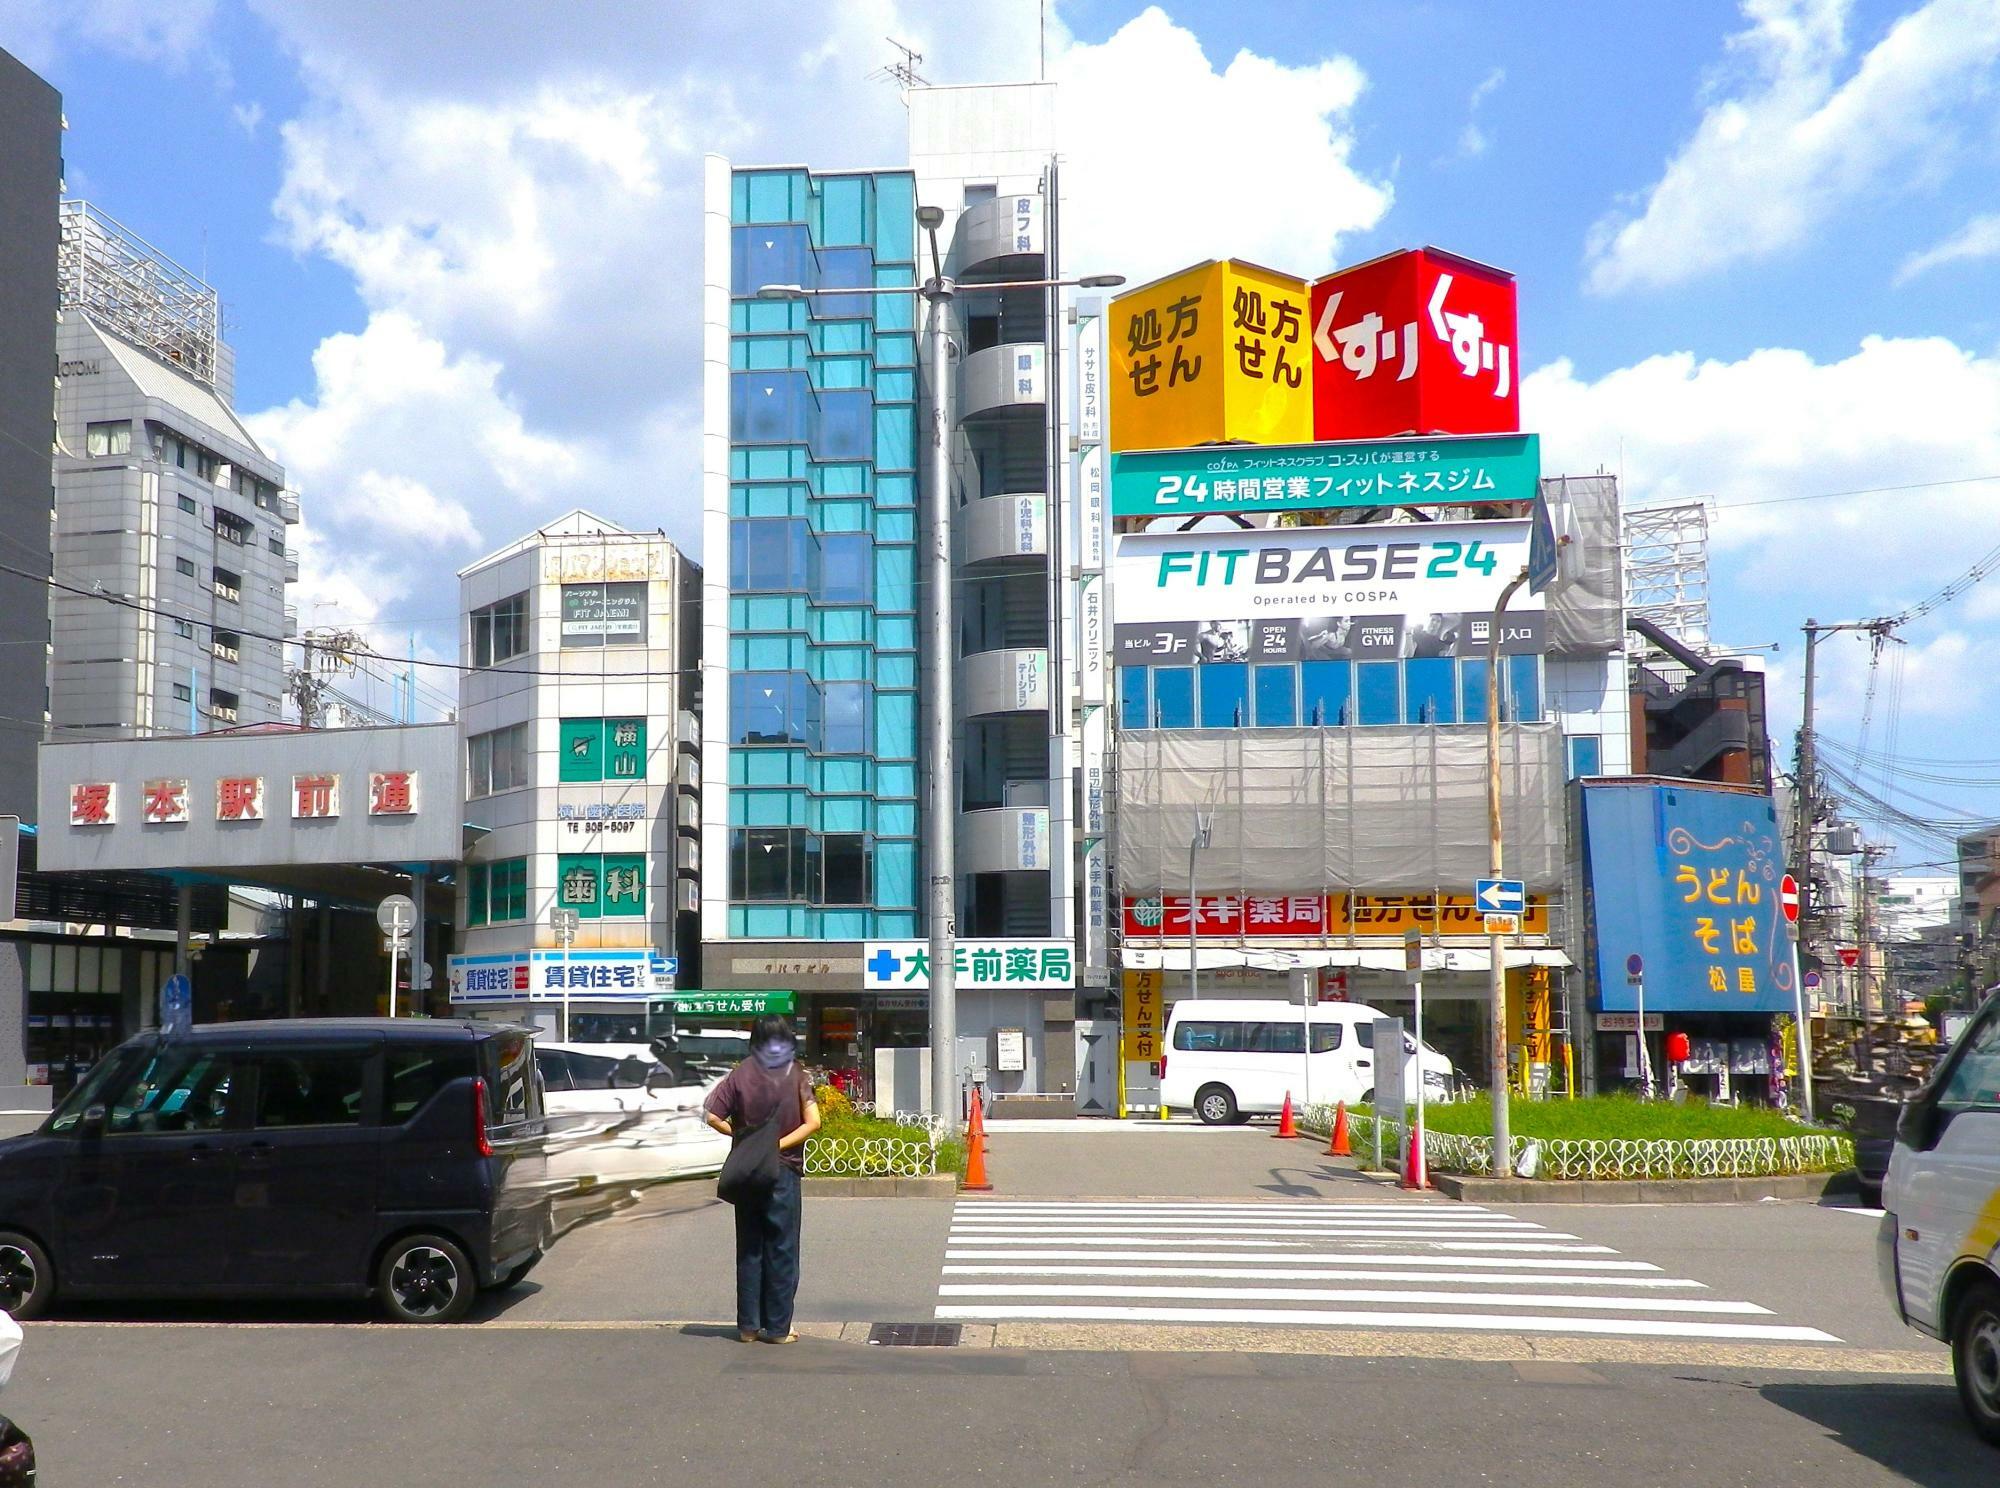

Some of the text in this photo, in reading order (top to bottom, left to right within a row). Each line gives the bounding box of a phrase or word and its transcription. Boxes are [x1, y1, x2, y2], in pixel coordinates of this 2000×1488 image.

[1017, 199, 1031, 251] 皮フ科
[1127, 295, 1202, 358] 処方
[1232, 285, 1302, 344] 処方
[1313, 291, 1418, 381] くすり
[1427, 273, 1510, 399] くすり
[1018, 355, 1032, 394] 眼科
[1129, 344, 1202, 397] せん
[1234, 336, 1302, 389] せん
[1084, 347, 1096, 418] ササセ皮フ科
[1244, 456, 1325, 469] フィットネスクラブ
[1090, 467, 1100, 522] 松岡眼科
[1155, 468, 1496, 505] 24時間営業フィットネスジム
[574, 609, 591, 618] FIT
[1253, 591, 1399, 606] Operated by COSPA
[1088, 592, 1099, 672] 石井クリニック
[1124, 632, 1188, 654] 当ビル 3F
[1263, 634, 1286, 647] 24
[1361, 627, 1395, 635] FITNESS
[1361, 635, 1394, 647] GYM
[1018, 663, 1027, 708] テーション
[1028, 653, 1037, 692] リハビリ
[614, 721, 639, 776] 横山
[72, 770, 413, 823] 塚本駅前通
[559, 803, 647, 820] 横山歯科医院
[1022, 813, 1036, 867] 整形外科
[562, 865, 646, 904] 歯科
[1090, 856, 1102, 927] 大手前薬局
[1675, 863, 1761, 906] うどん
[1172, 895, 1321, 924] スギ薬局
[1341, 895, 1538, 923] 処方せん
[1693, 916, 1759, 955] そば
[466, 968, 509, 991] 賃貸住宅
[544, 965, 635, 988] 賃貸住宅
[1708, 966, 1757, 993] 松屋
